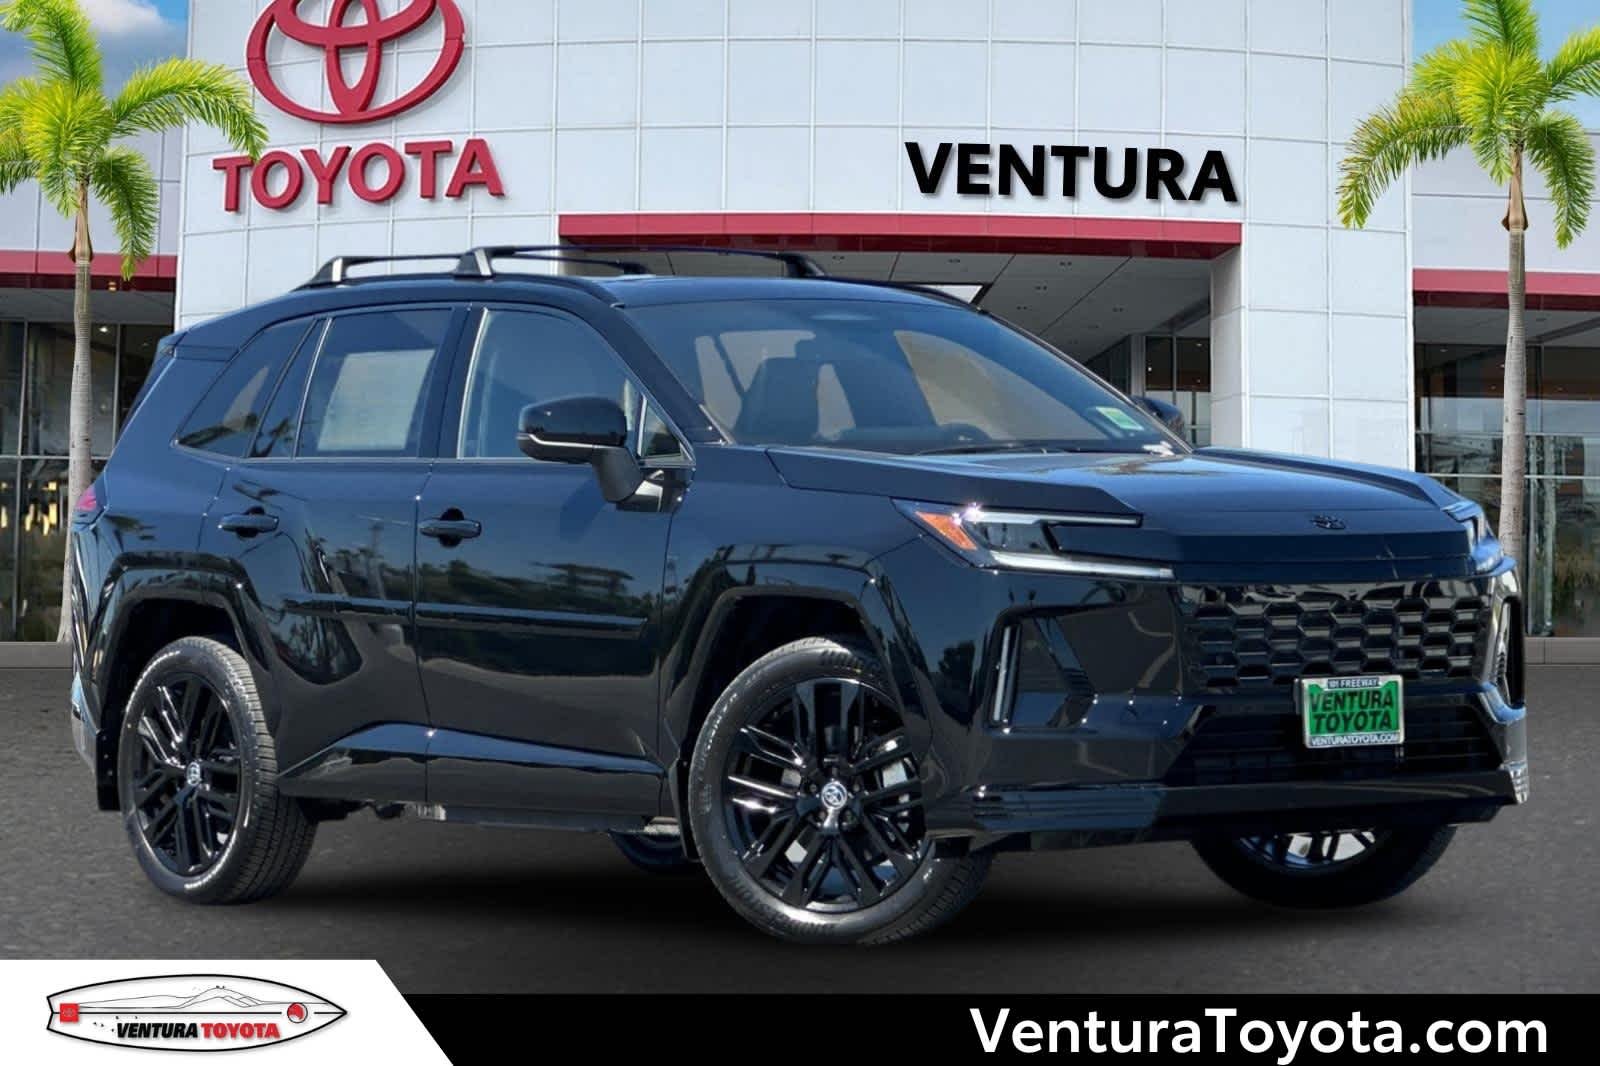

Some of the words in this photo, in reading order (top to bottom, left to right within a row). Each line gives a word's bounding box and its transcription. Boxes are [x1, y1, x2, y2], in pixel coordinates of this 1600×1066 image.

[212, 138, 505, 212] TOYOTA
[904, 142, 1238, 202] VENTURA
[1340, 679, 1377, 688] FREEWAY
[1310, 689, 1394, 712] VENTURA
[1313, 711, 1393, 735] TOYOTA
[1311, 733, 1399, 746] VENTURATOYOTA.COM
